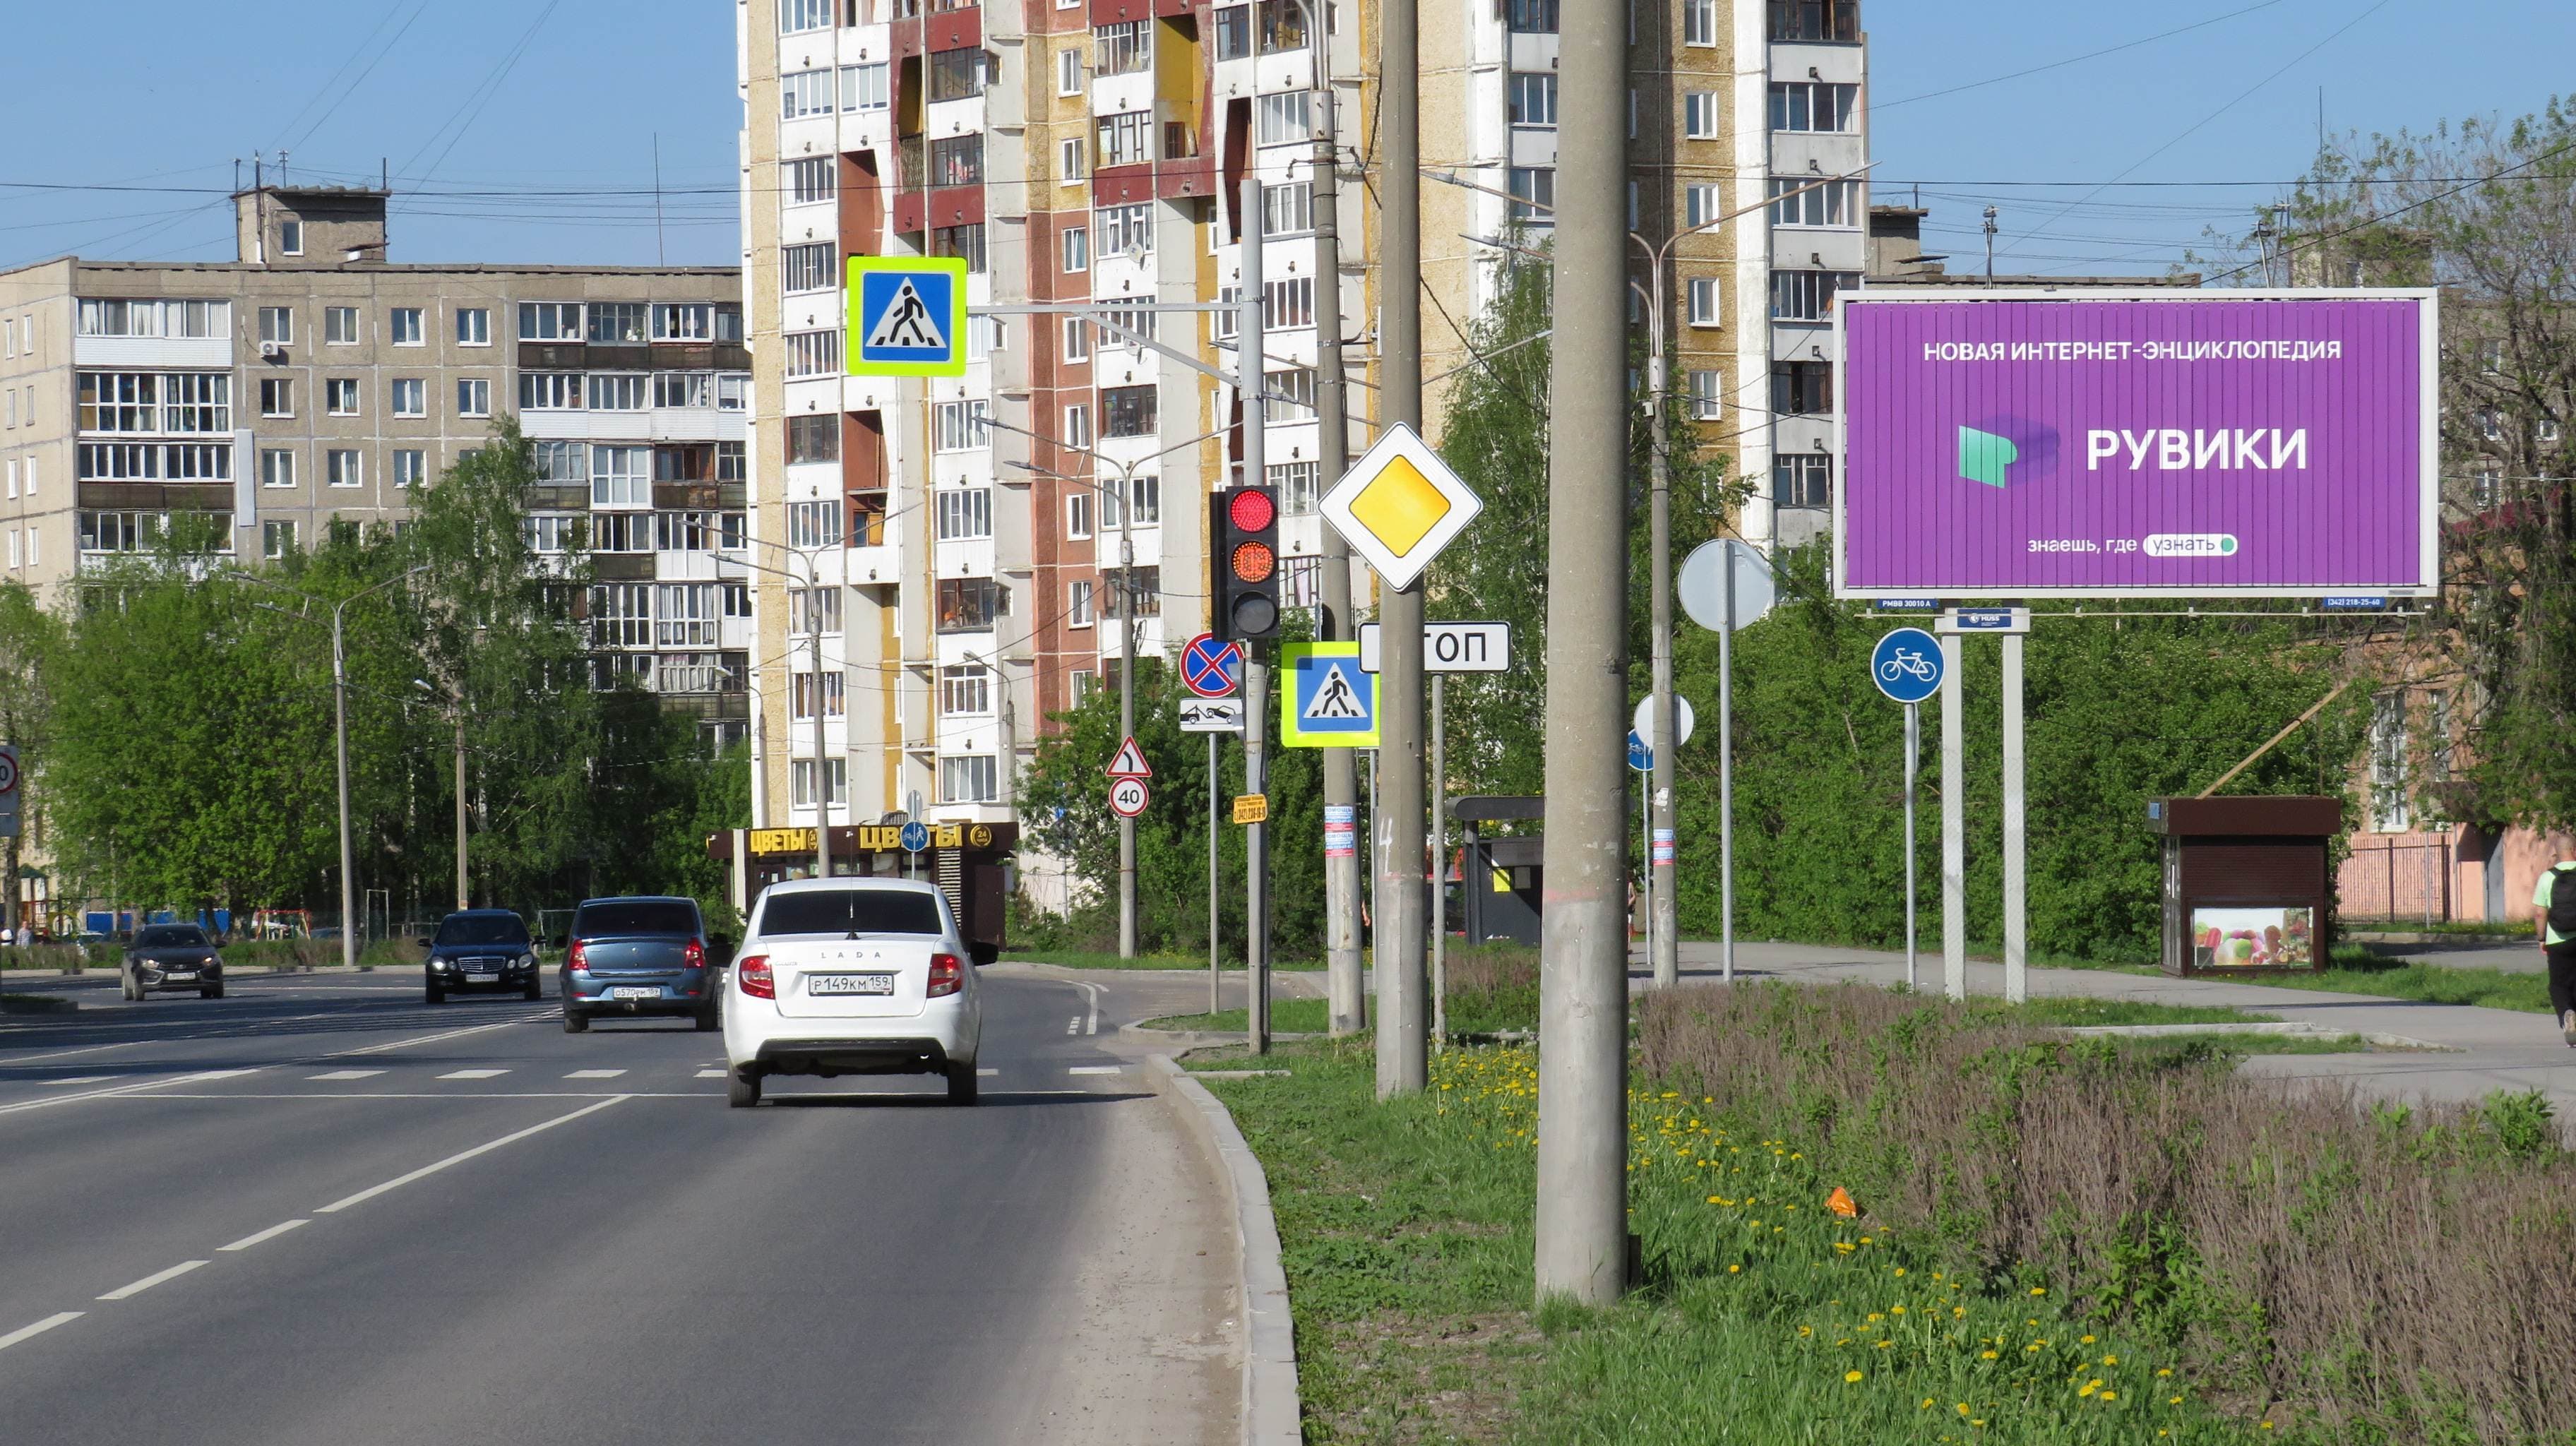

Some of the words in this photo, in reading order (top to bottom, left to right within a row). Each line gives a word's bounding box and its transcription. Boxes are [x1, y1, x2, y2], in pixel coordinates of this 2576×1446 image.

[1924, 342, 2004, 362] НОВАЯ
[2011, 340, 2342, 362] ИНТЕРНЕТ-ЭНЦИКЛОПЕДИЯ
[2087, 429, 2307, 470] РУВИКИ
[2027, 539, 2101, 554] знаешь,
[2106, 539, 2137, 553] где
[2153, 539, 2216, 555] узнать
[1118, 789, 1140, 804] 40
[751, 828, 807, 856] ЦВЕТЫ
[859, 825, 963, 853] ЦВТЫ
